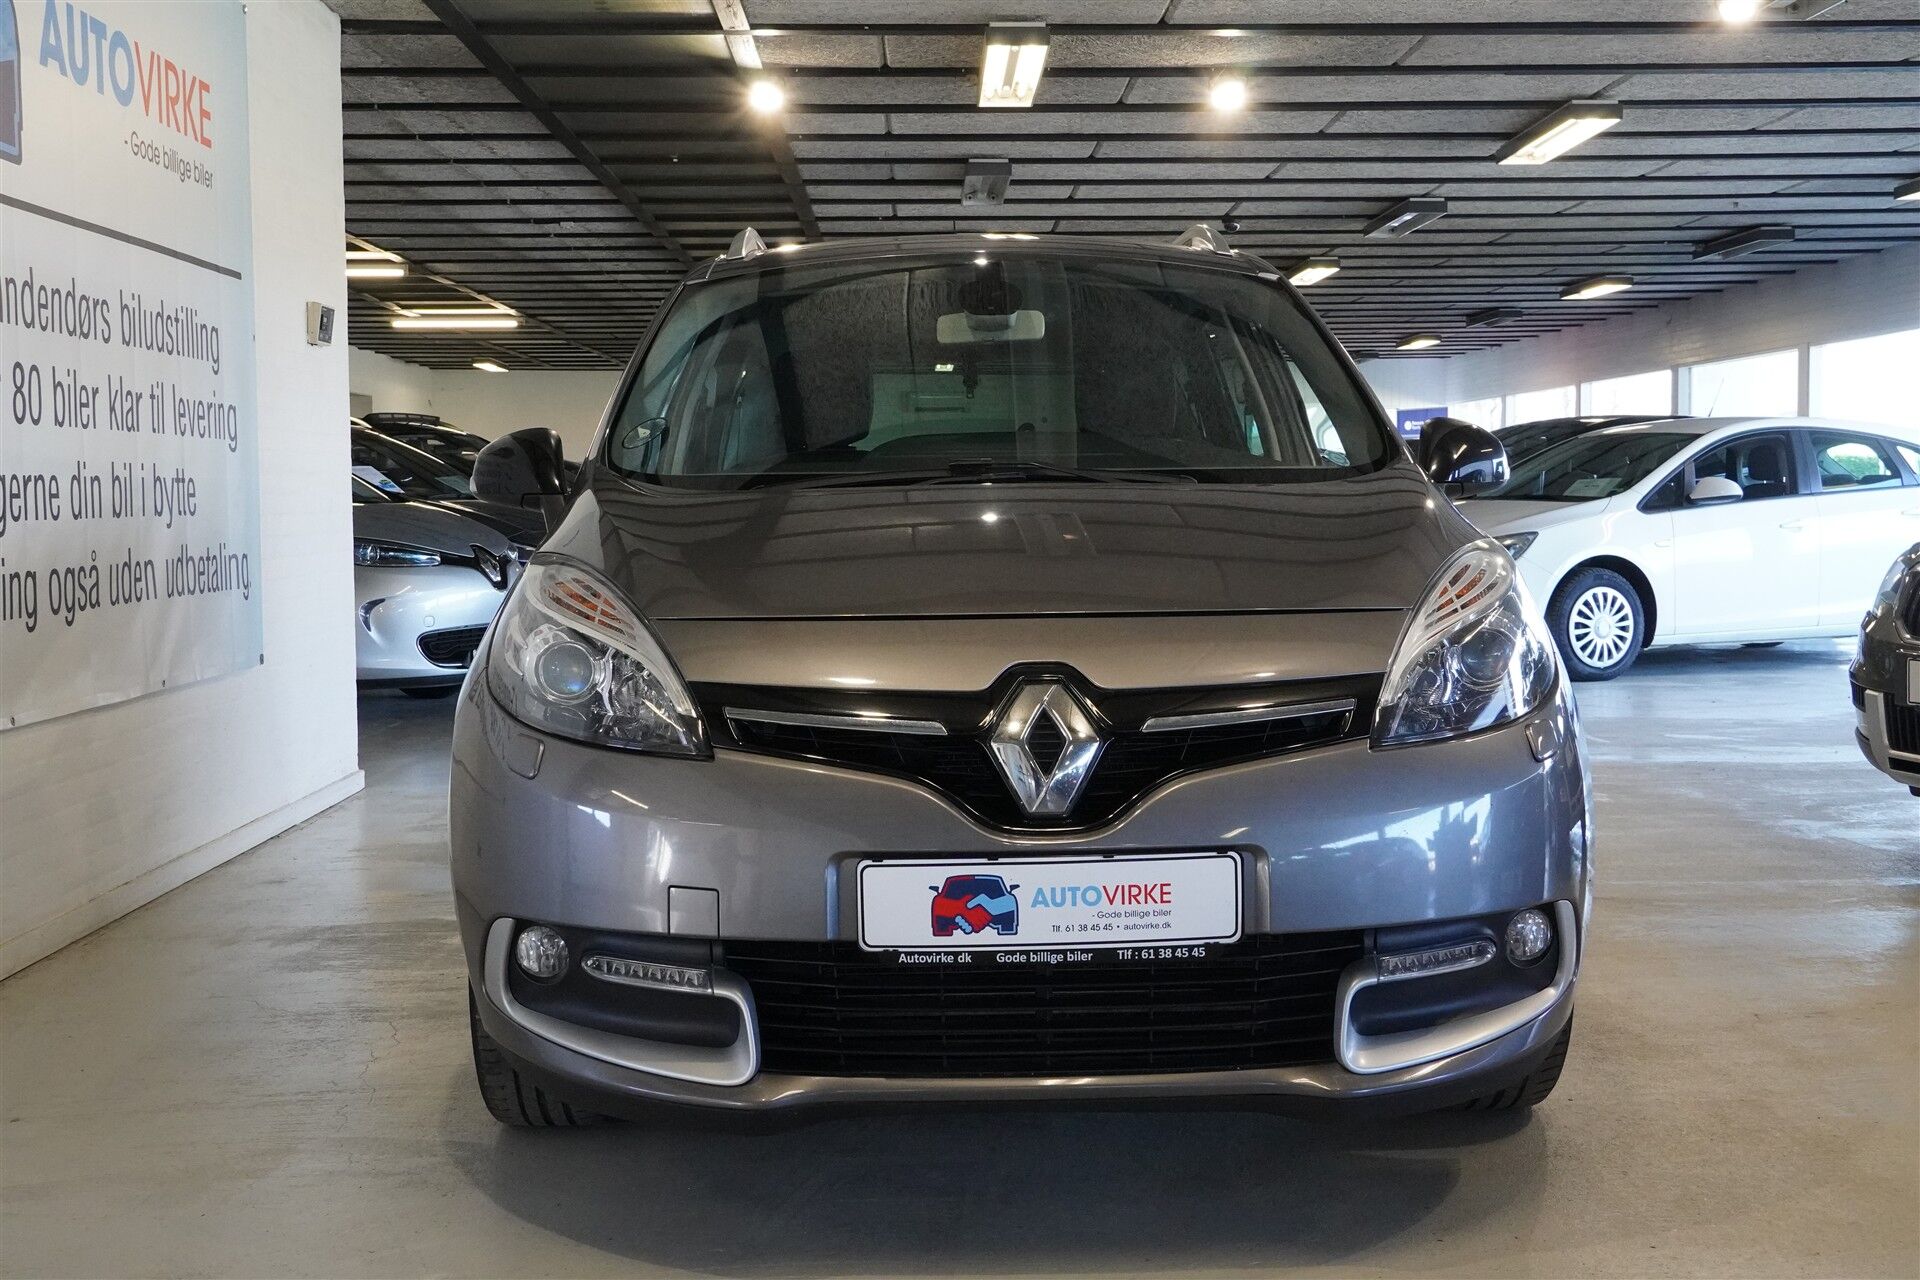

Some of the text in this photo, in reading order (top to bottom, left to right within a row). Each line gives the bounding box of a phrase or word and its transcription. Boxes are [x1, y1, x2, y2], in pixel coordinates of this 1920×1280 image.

[39, 0, 212, 149] AUTOVIRKE
[130, 131, 160, 165] Gode
[162, 145, 192, 183] billige
[193, 160, 213, 189] biler
[119, 289, 220, 375] biludstilling
[12, 361, 238, 453] 80 biler klar til levering
[70, 460, 102, 520] din
[111, 461, 133, 519] bil
[141, 463, 146, 517] i
[153, 463, 197, 529] bytte
[49, 550, 100, 627] også
[109, 547, 158, 606] uden
[1030, 883, 1172, 908] AUTOVIRKE
[1052, 921, 1172, 933] Tlf. 61 38 45 45 autovirke.dk
[1097, 910, 1122, 919] Gode
[1124, 910, 1151, 919] billige
[1153, 909, 1172, 917] biler
[899, 953, 954, 963] Autovirke
[957, 952, 972, 963] dk
[996, 952, 1027, 963] Gode
[1030, 951, 1064, 964] billige
[1067, 951, 1093, 962] biler
[1117, 949, 1132, 960] Tlf
[1141, 948, 1155, 959] 61
[1158, 948, 1172, 958] 38
[1174, 947, 1189, 958] 45
[1191, 947, 1206, 957] 45
